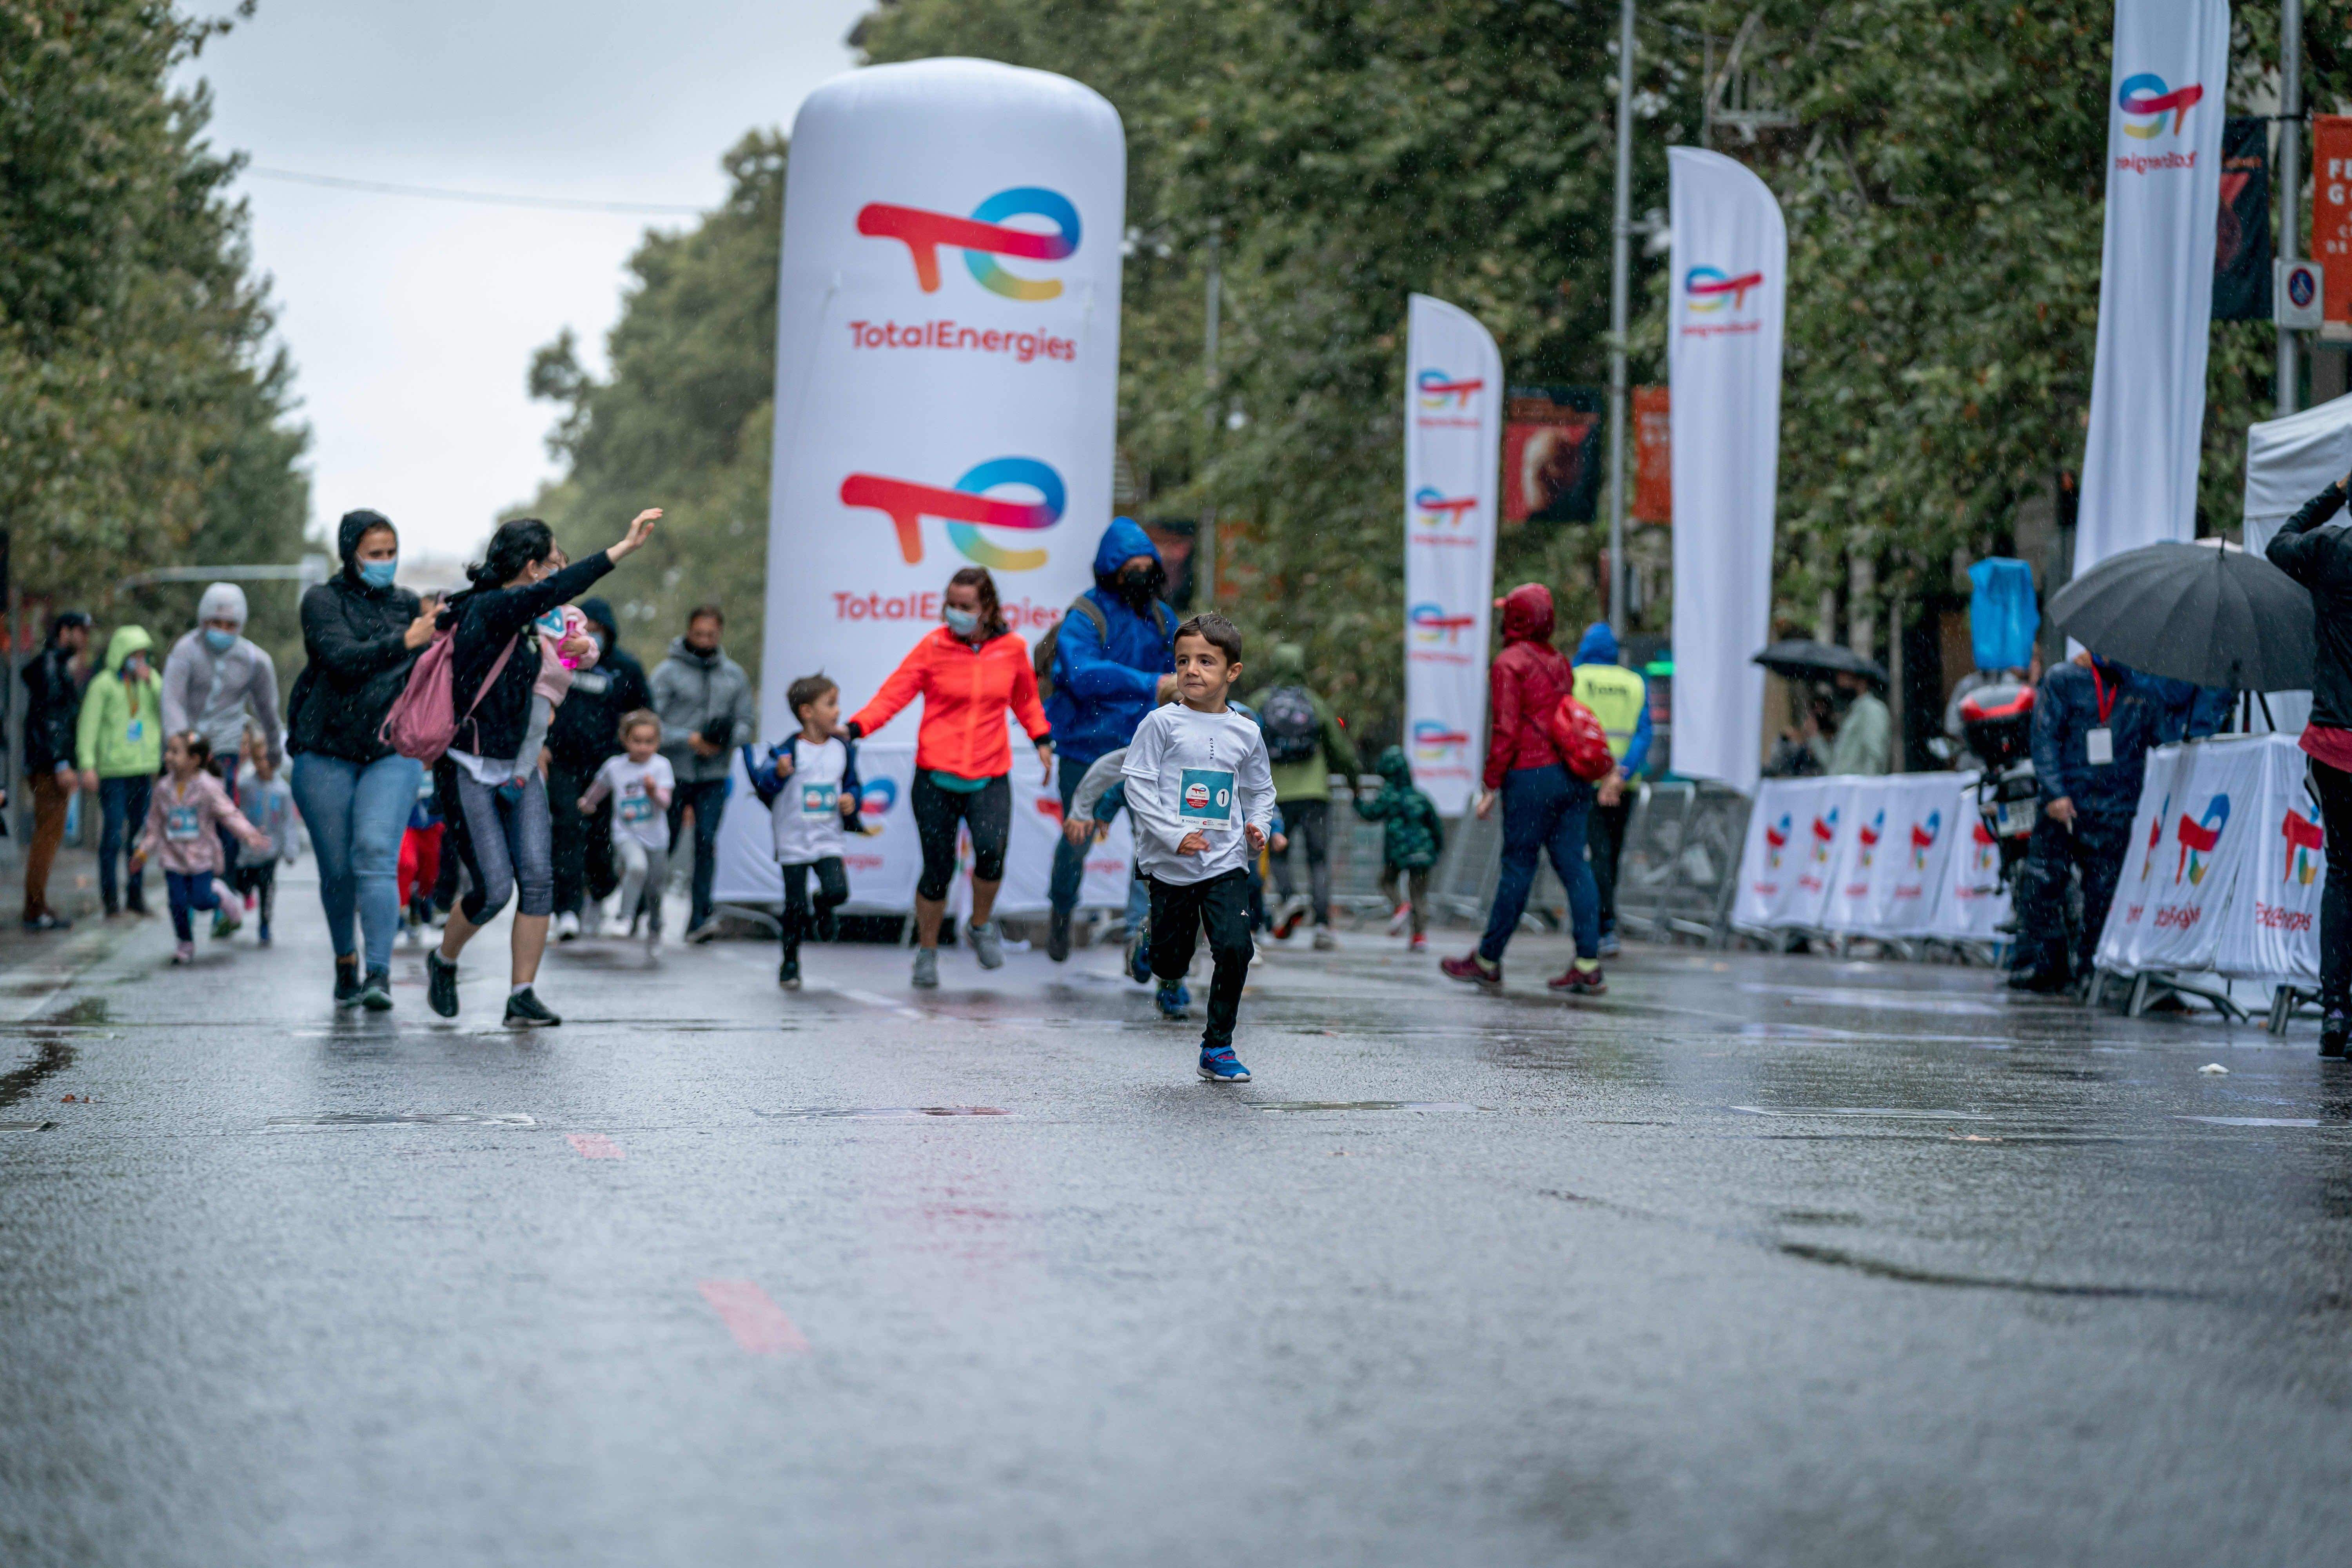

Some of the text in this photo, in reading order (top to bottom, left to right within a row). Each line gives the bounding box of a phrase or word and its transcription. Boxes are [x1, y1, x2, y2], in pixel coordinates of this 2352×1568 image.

[2328, 183, 2352, 205] G
[849, 319, 1076, 362] TotalEnergies
[833, 592, 1062, 630] TotalEgies
[1221, 791, 1225, 805] 1
